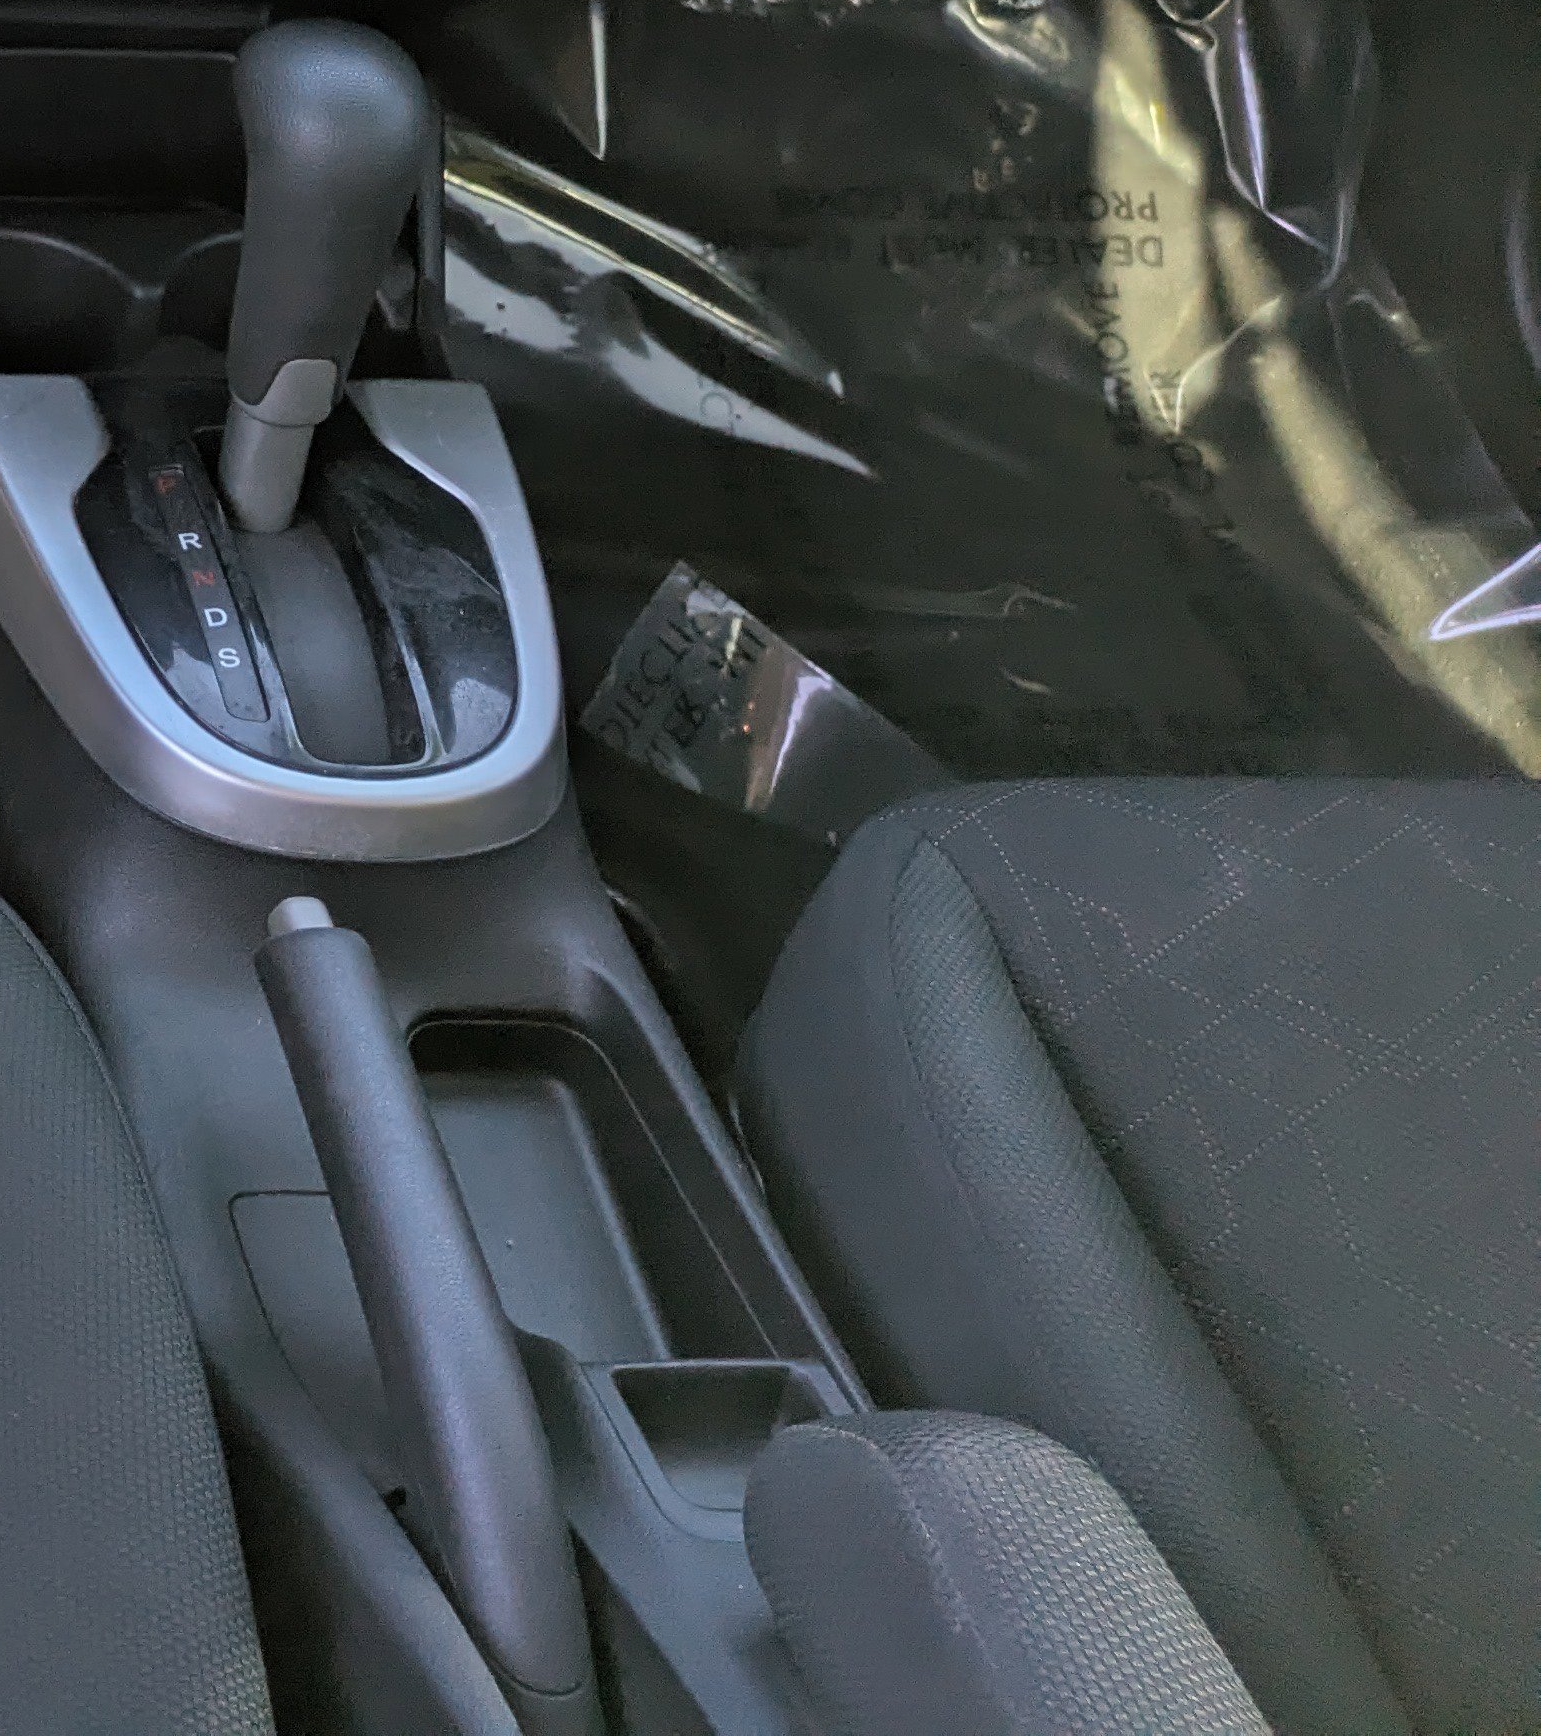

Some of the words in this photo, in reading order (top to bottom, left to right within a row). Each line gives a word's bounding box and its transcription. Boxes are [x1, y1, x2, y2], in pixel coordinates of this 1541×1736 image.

[178, 532, 202, 551] R
[192, 571, 215, 586] N
[204, 608, 227, 627] D
[218, 648, 241, 668] S
